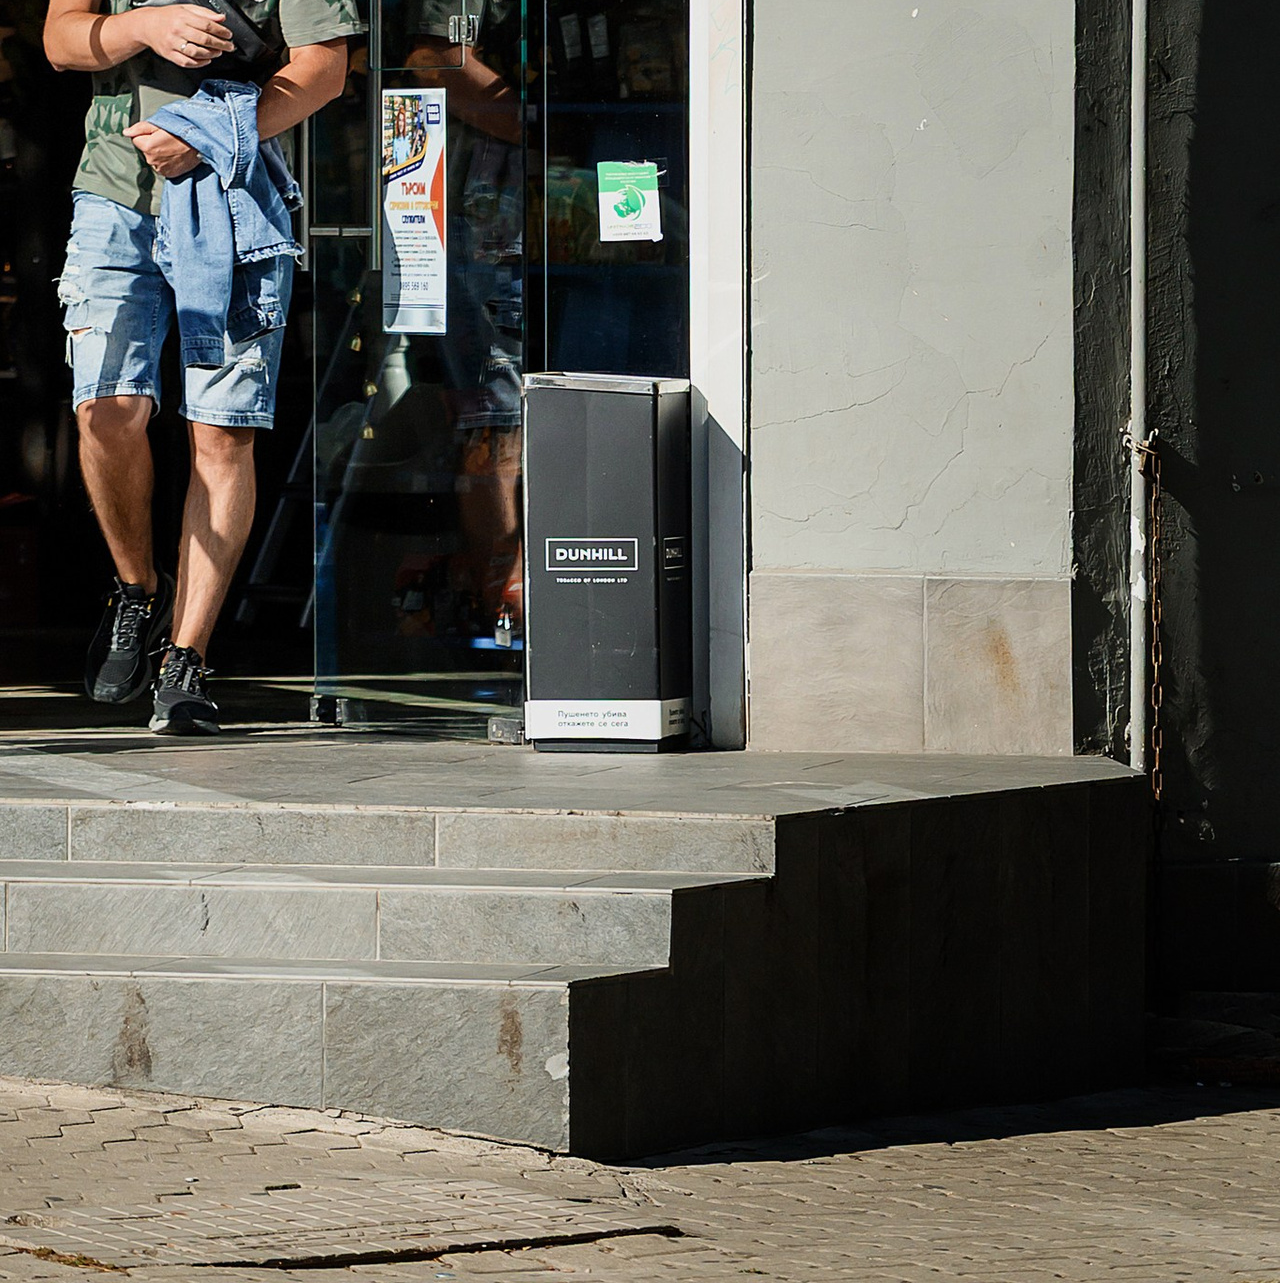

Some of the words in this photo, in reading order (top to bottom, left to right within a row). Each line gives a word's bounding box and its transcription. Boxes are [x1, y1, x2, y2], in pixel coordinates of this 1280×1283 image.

[555, 548, 628, 561] DUNHILL
[557, 710, 599, 719] Пушенето
[601, 710, 627, 719] убива
